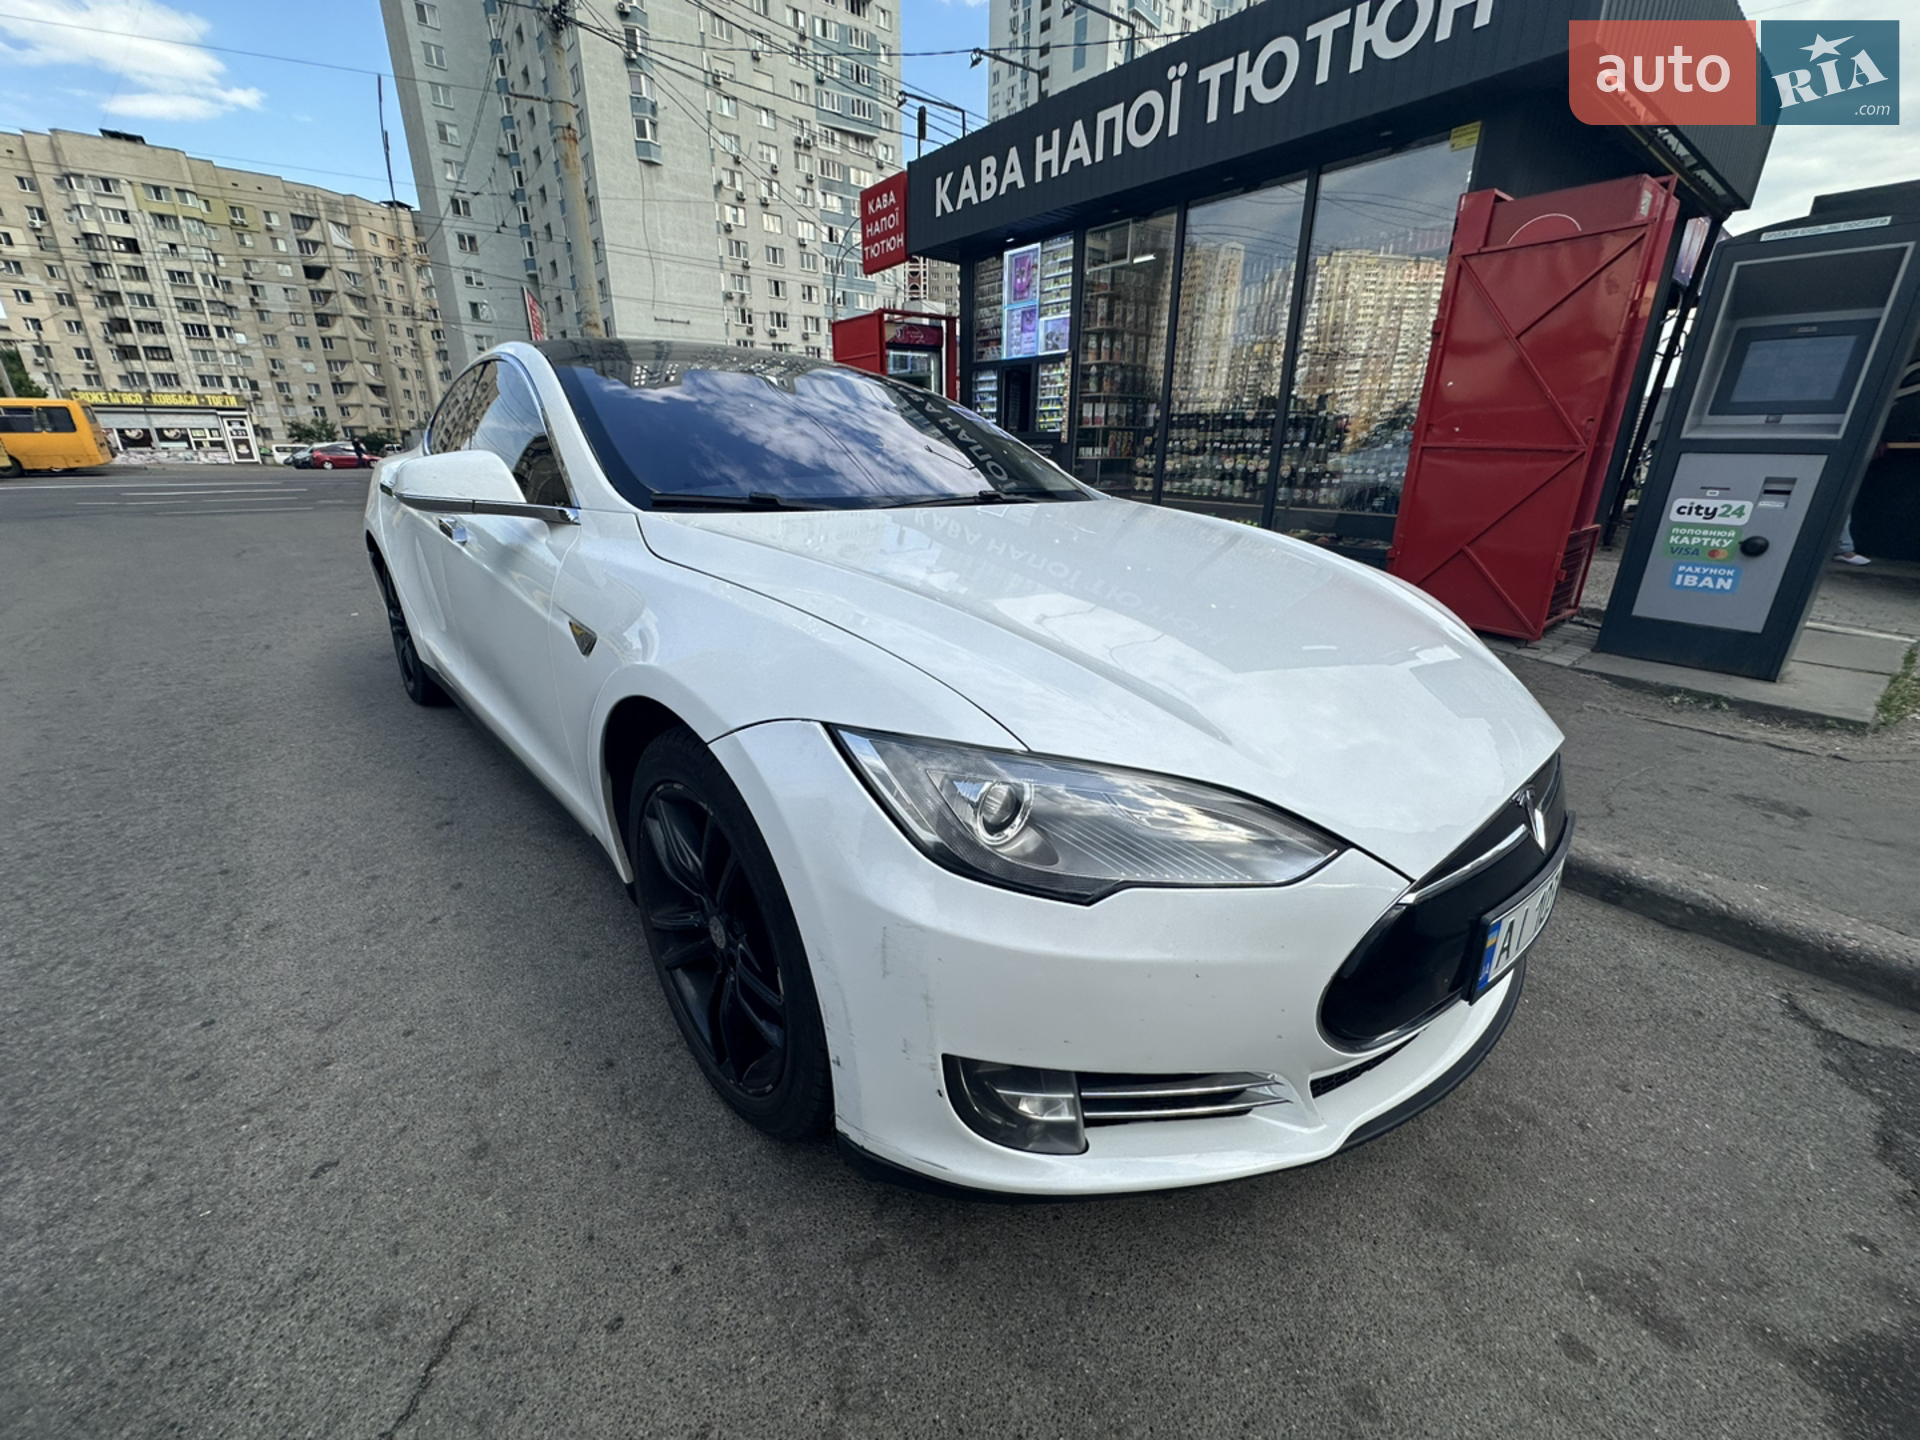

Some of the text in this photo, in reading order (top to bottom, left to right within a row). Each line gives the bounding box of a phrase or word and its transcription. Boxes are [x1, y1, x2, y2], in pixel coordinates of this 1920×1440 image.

[935, 146, 1025, 218] КАВА
[1034, 61, 1188, 184] НАПОЇ
[867, 190, 896, 215] КАВА
[866, 207, 900, 238] НАПОЇ
[864, 232, 904, 260] ТЮТЮН
[151, 393, 199, 405] КОВБАСИ
[205, 394, 238, 406] ТОРТИ
[1676, 501, 1746, 520] city24
[1671, 527, 1736, 538] ПОПОВНЮЙ
[1669, 535, 1733, 547] КАРТКУ
[1670, 546, 1700, 556] VISA
[1678, 565, 1735, 577] РАХУНОК
[1675, 574, 1733, 590] IBAN
